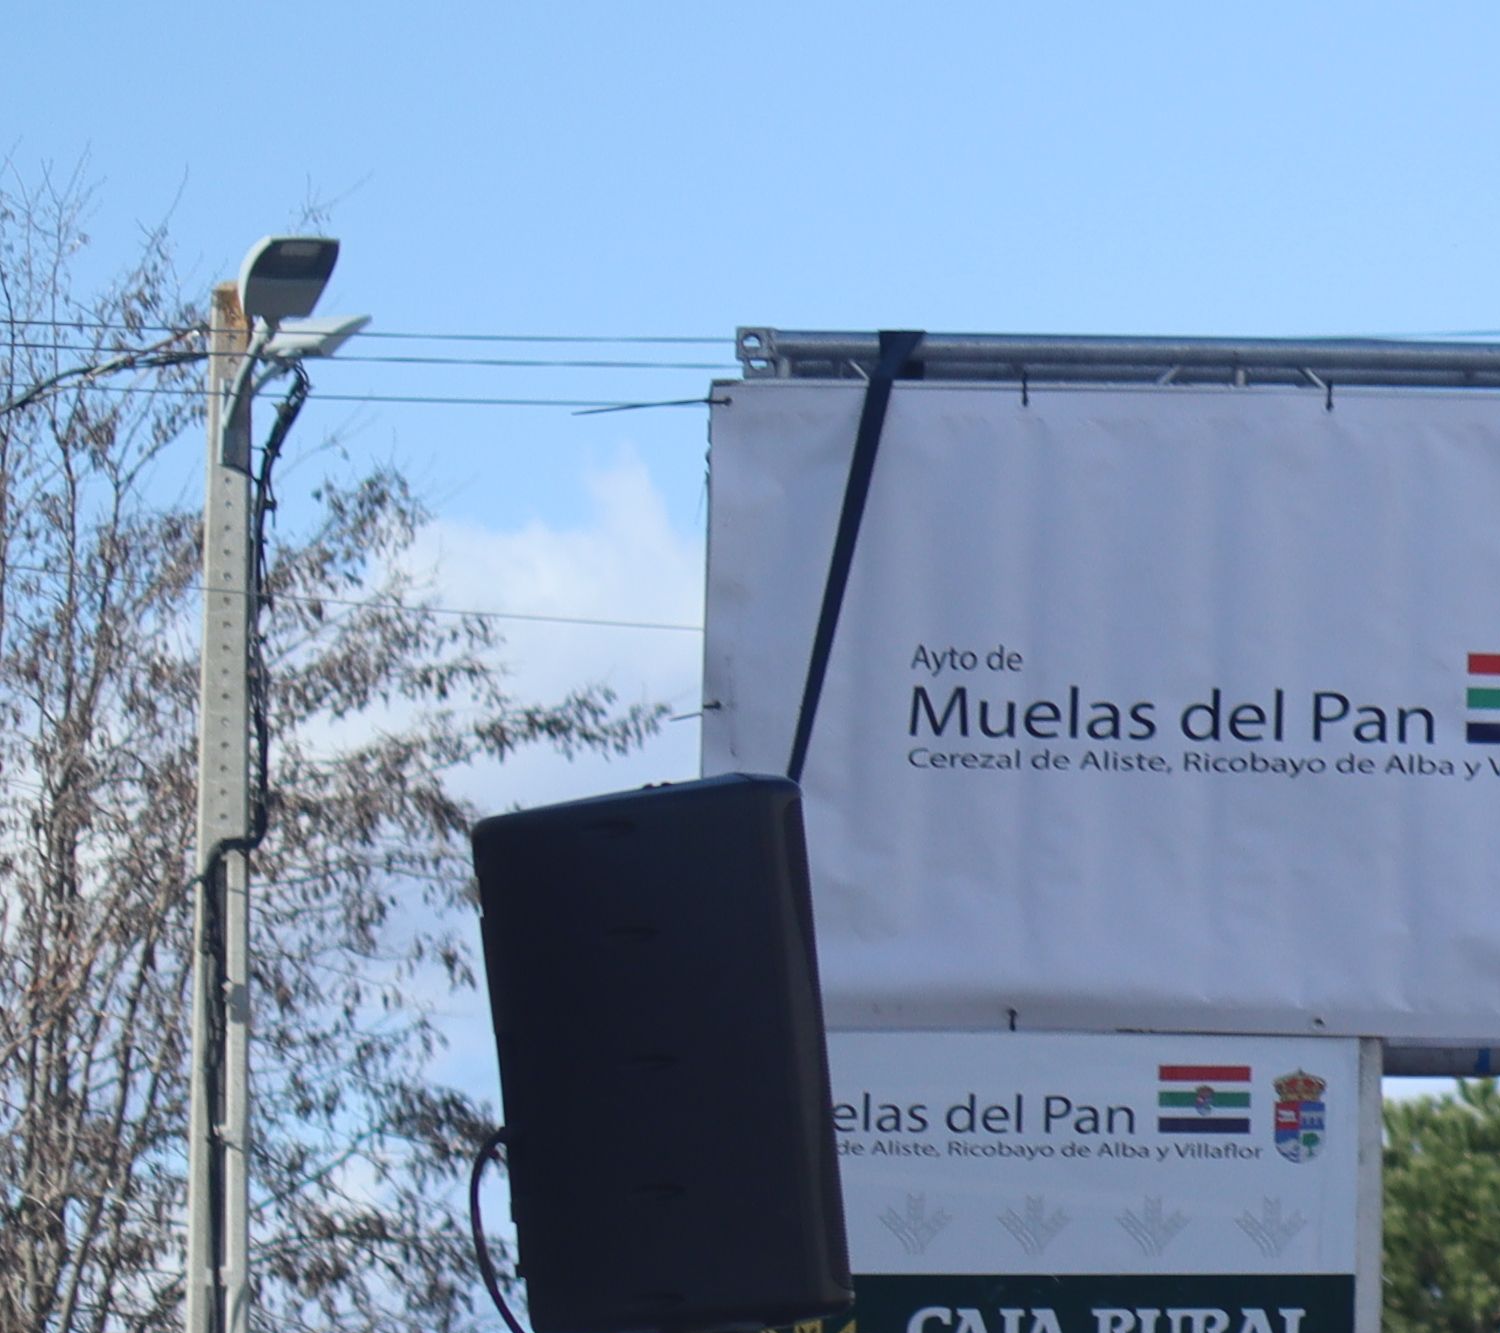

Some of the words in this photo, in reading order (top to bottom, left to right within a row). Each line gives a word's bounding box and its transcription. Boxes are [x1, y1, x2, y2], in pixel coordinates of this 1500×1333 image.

[912, 645, 977, 676] Ayto
[987, 645, 1022, 671] de
[910, 686, 1156, 740] Muelas
[1181, 688, 1283, 741] del
[1313, 692, 1433, 743] Pan
[908, 748, 1021, 771] Cerezal
[1031, 749, 1069, 771] de
[1080, 750, 1172, 777] Aliste,
[1184, 752, 1326, 778] Ricobayo
[1336, 753, 1375, 774] de
[1385, 754, 1453, 775] Alba
[1464, 762, 1481, 781] y
[833, 1093, 929, 1135] elas
[946, 1094, 1022, 1133] del
[1045, 1096, 1134, 1134] Pan
[872, 1140, 940, 1156] Aliste,
[948, 1141, 1054, 1160] Ricobayo
[1061, 1142, 1091, 1157] de
[1098, 1142, 1149, 1157] Alba
[1156, 1147, 1169, 1161] y
[1174, 1143, 1262, 1158] Villaflor
